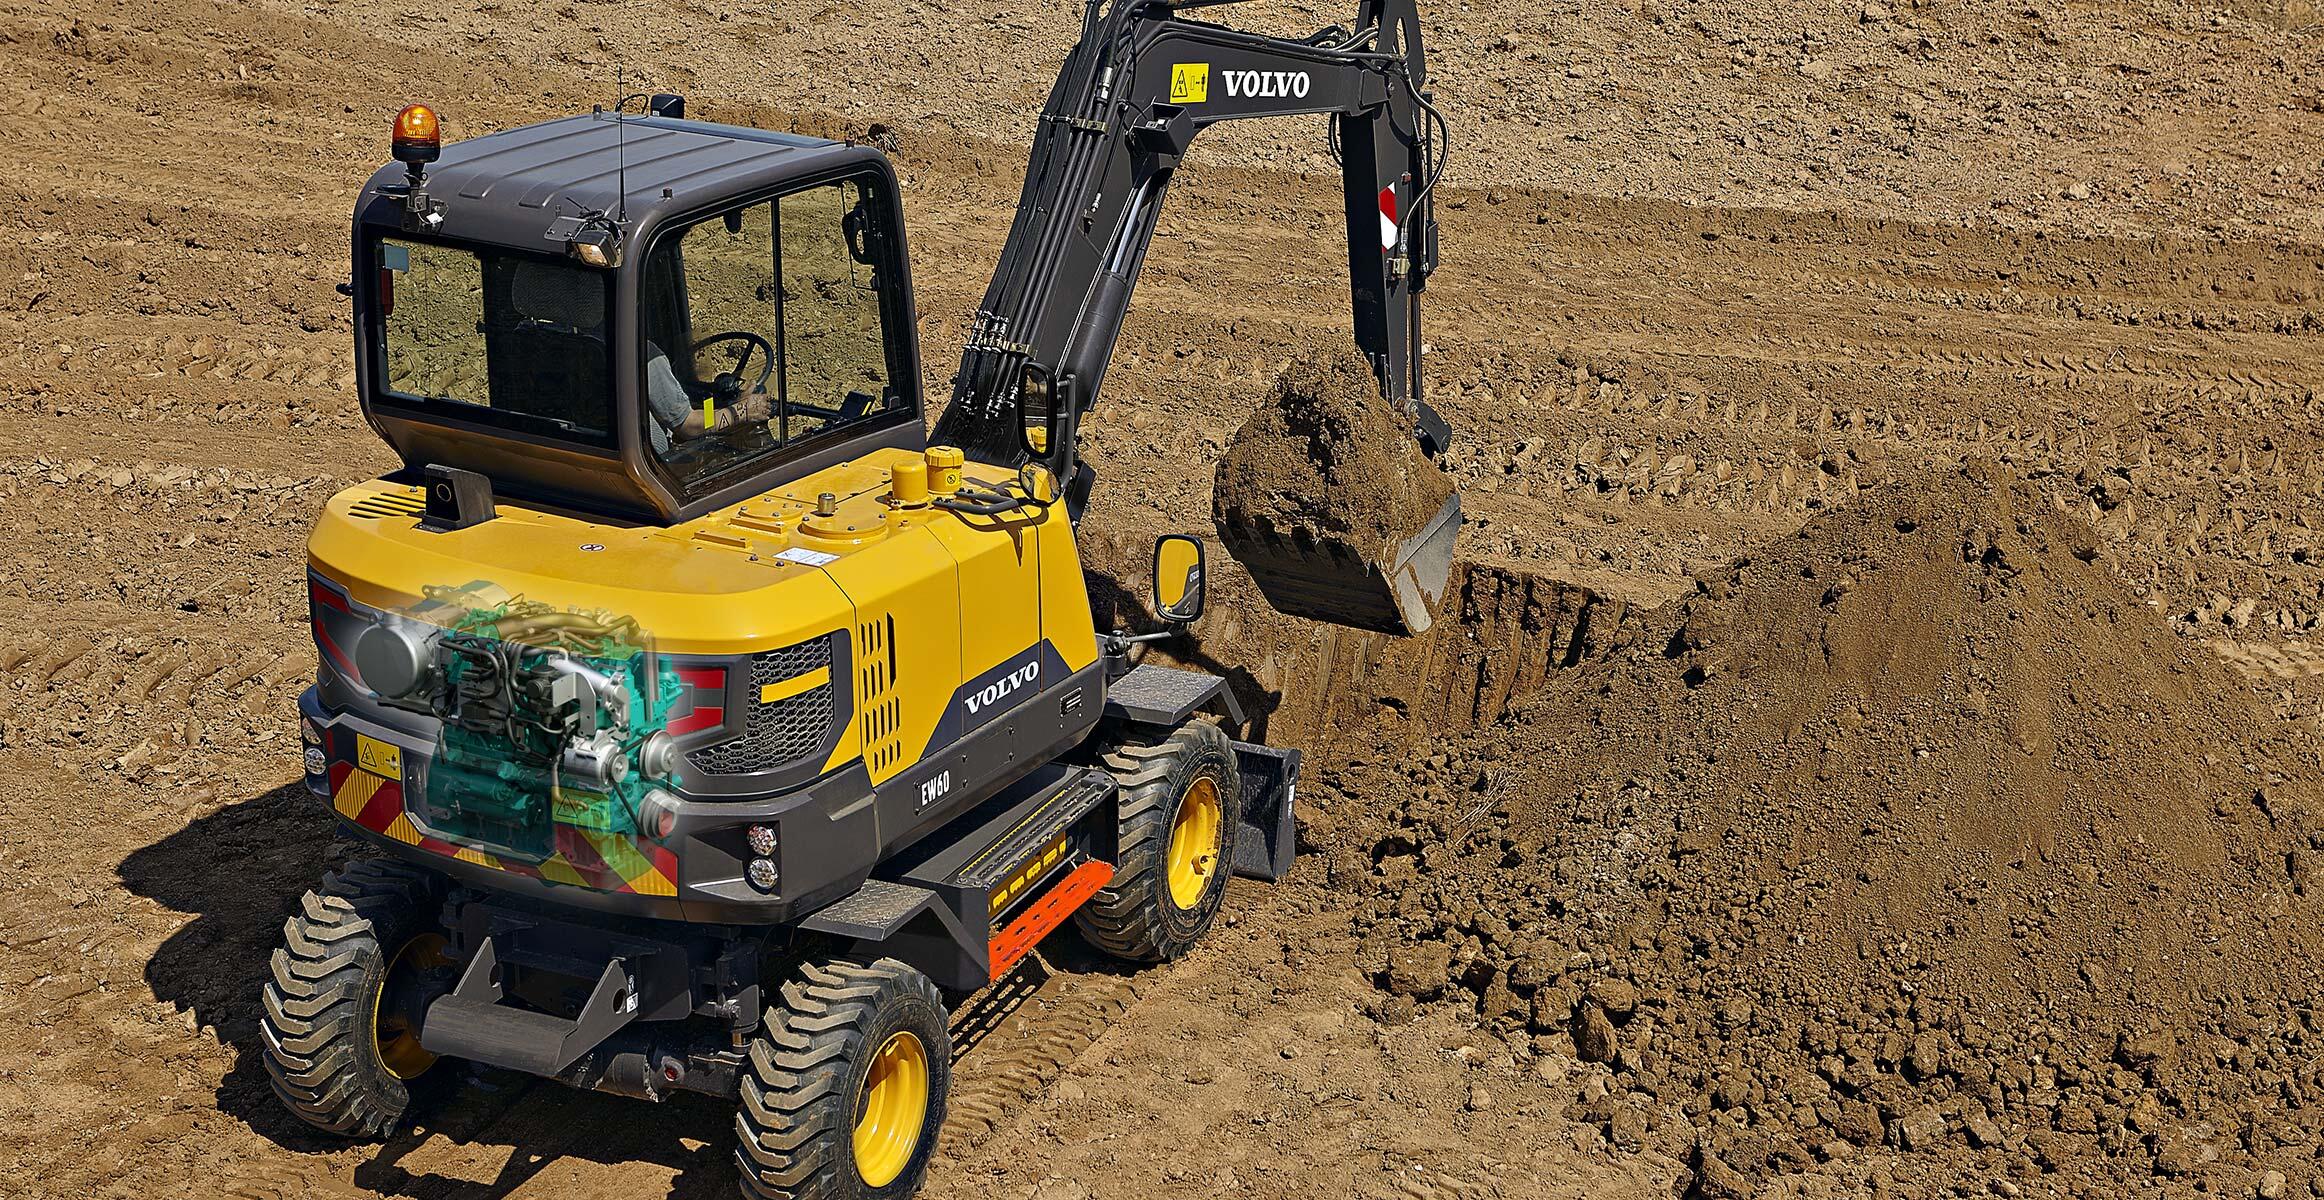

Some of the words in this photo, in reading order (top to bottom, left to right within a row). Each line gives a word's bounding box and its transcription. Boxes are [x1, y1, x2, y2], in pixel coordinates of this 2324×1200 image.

[1222, 70, 1310, 98] VOLVO
[964, 660, 1039, 715] VOLVO
[921, 770, 950, 806] EW60
